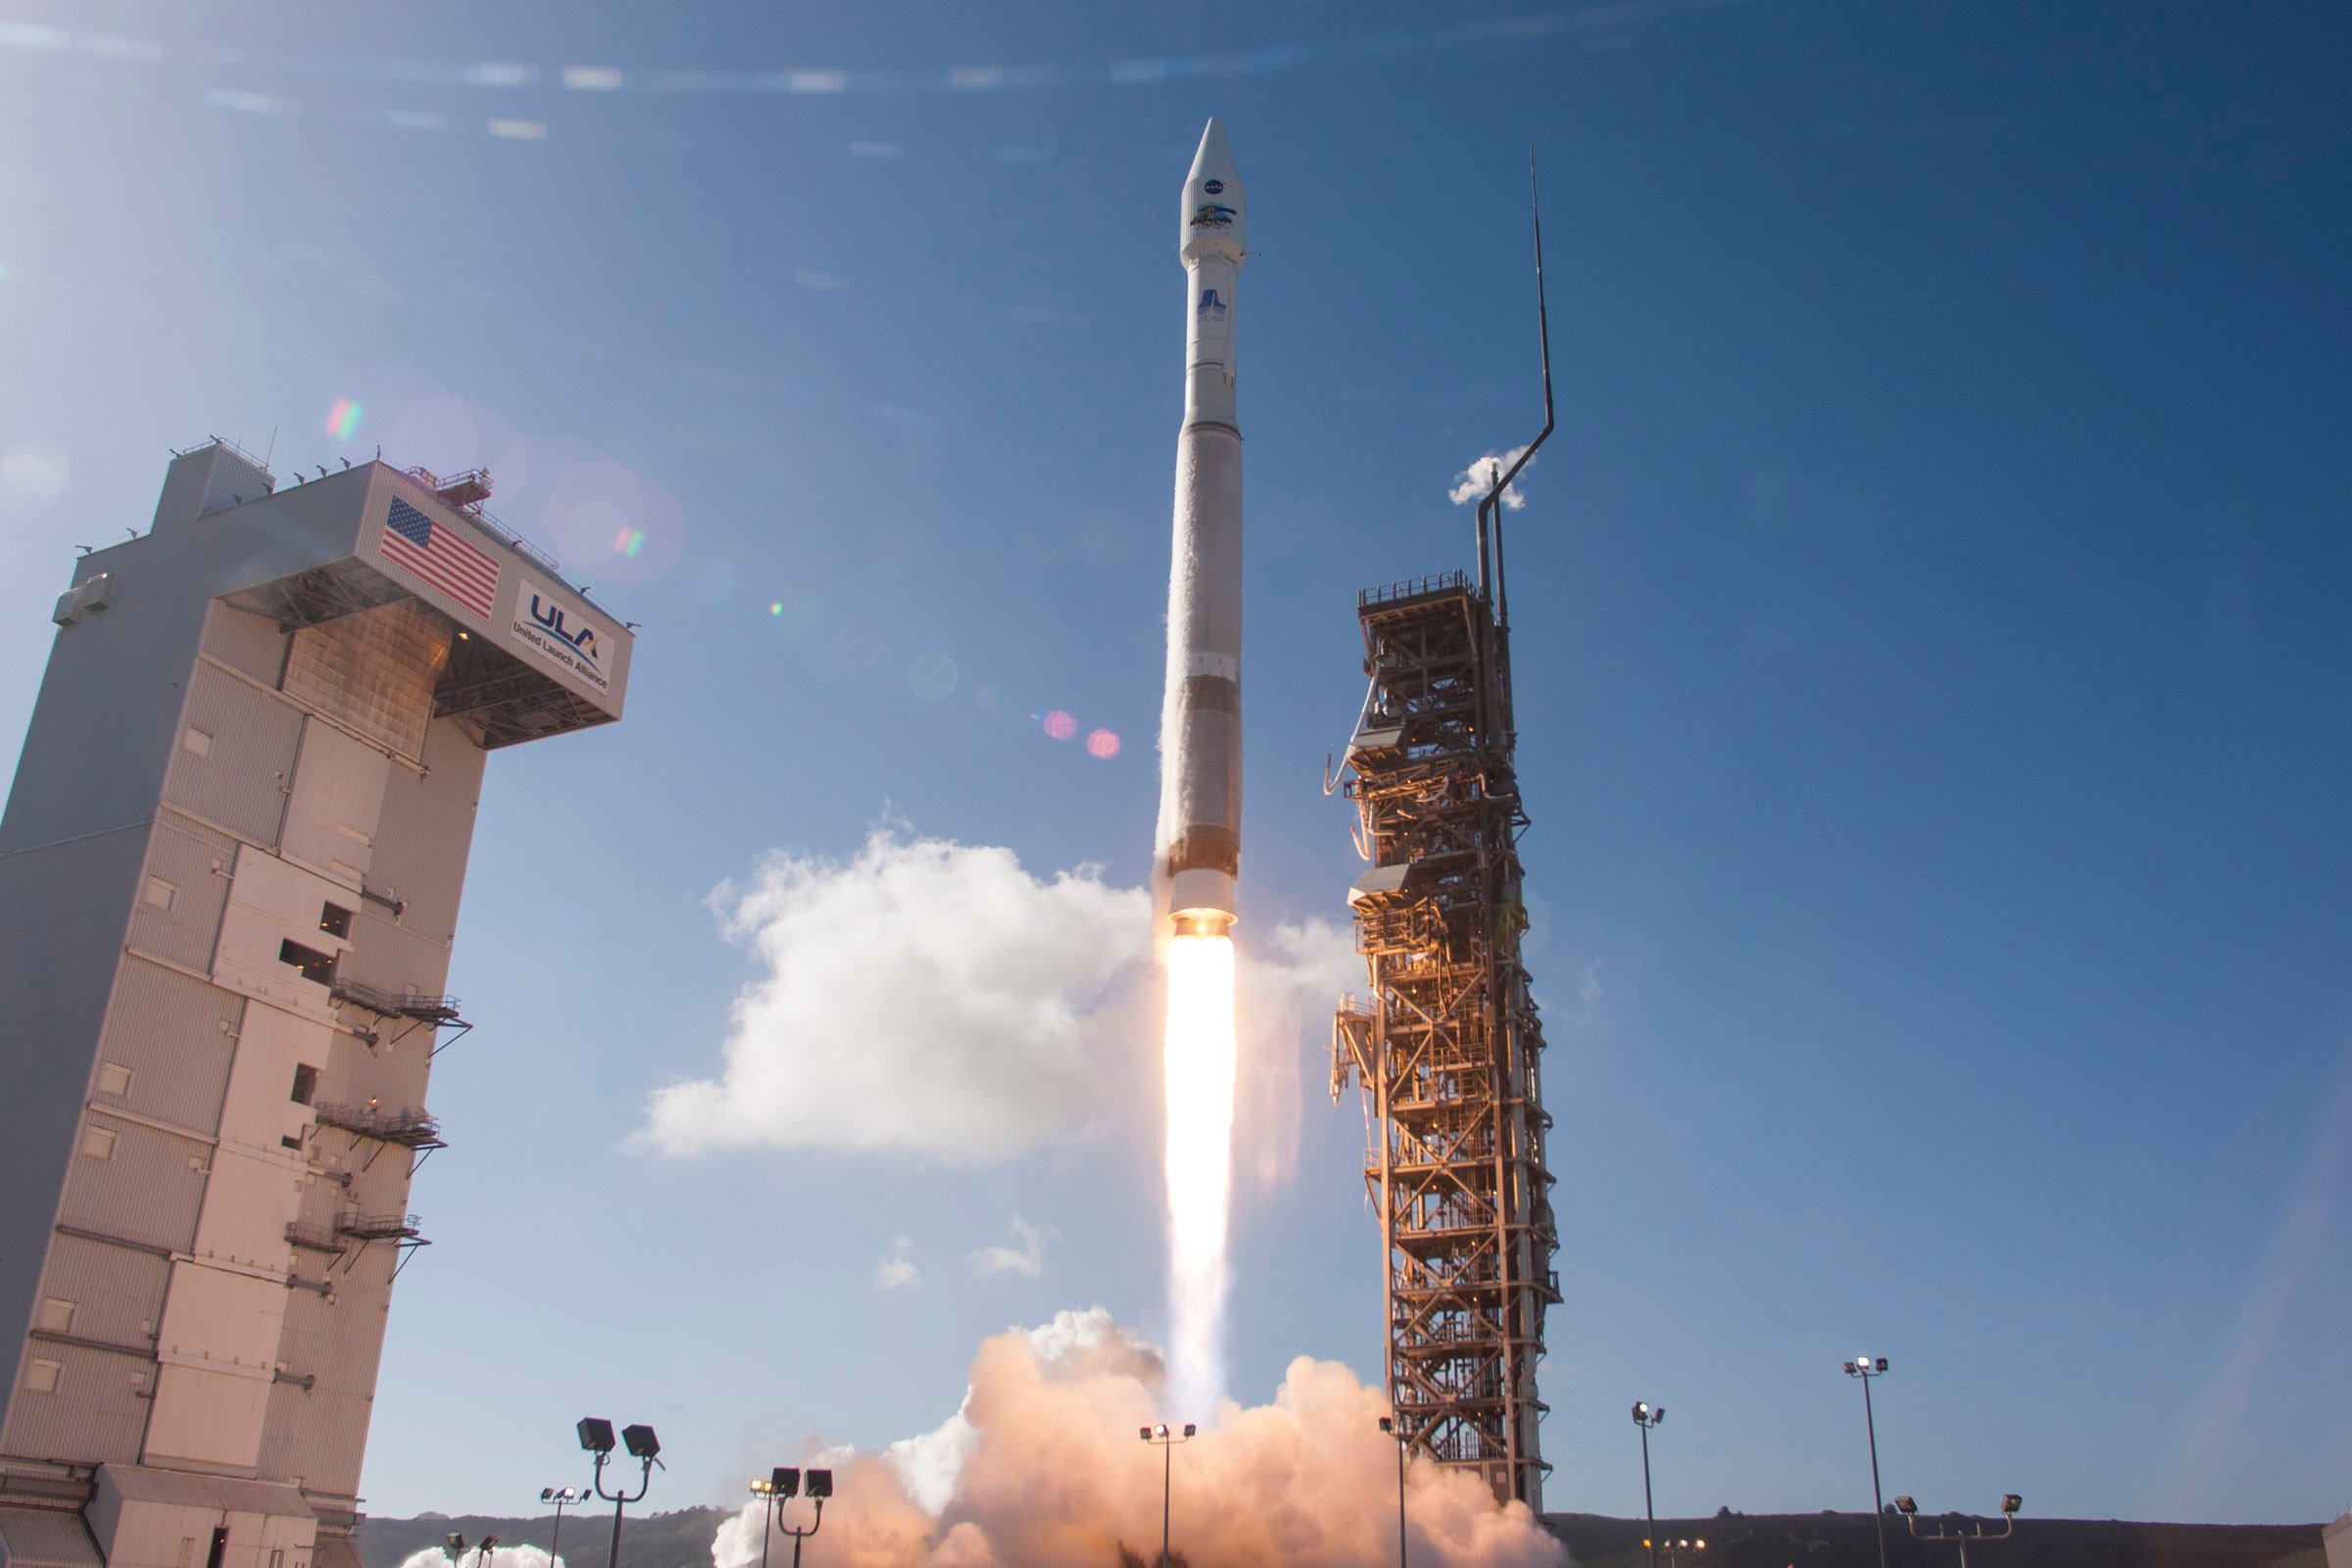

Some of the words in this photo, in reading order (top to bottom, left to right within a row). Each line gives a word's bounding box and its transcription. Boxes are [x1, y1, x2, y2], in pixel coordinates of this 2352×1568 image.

[514, 621, 542, 647] United
[543, 640, 573, 667] Launch
[574, 662, 608, 688] Alliance
[530, 594, 599, 659] ULA
